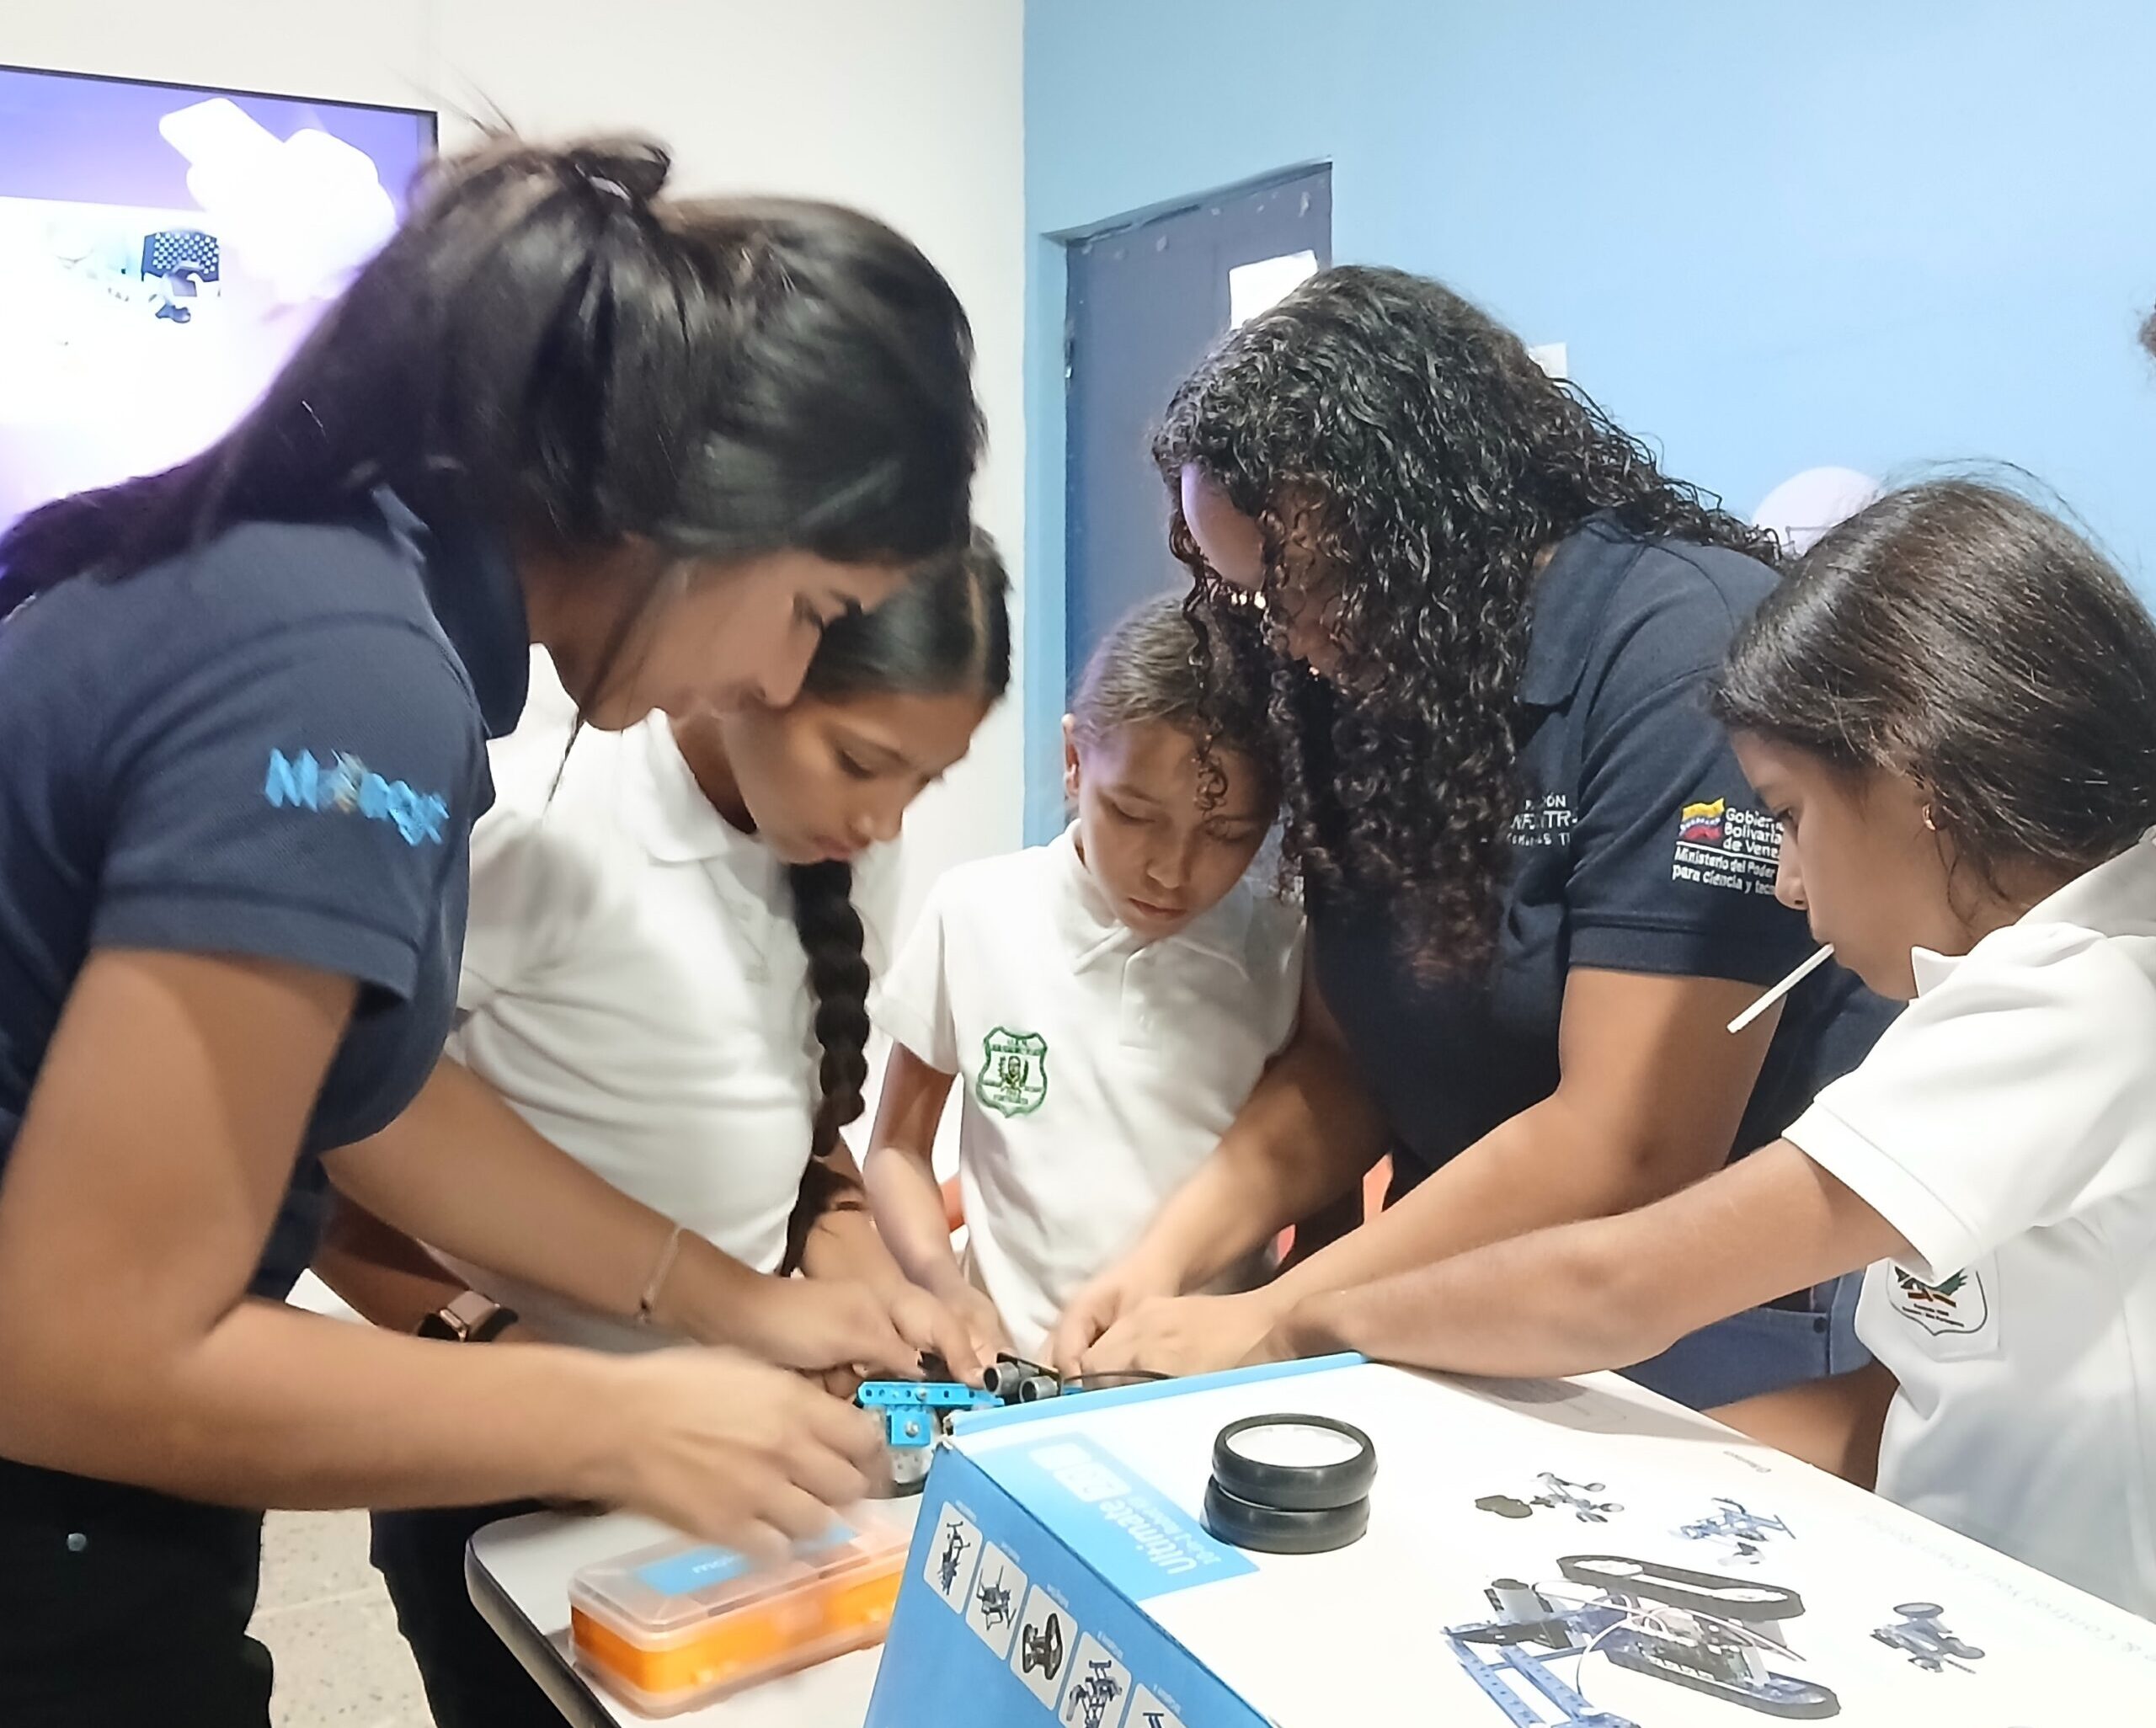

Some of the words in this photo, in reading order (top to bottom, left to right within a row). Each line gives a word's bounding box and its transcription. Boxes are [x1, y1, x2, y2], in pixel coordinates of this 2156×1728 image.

[1722, 837, 1742, 851] de
[1745, 840, 1780, 859] Vene
[1724, 822, 1783, 845] Bolivaria
[1674, 845, 1729, 870] Ministerio
[1730, 858, 1746, 873] del
[1748, 861, 1775, 878] Poder
[1672, 864, 1700, 881] para
[1702, 870, 1742, 890] ciencia
[1744, 881, 1752, 893] y
[1099, 1498, 1197, 1575] Ultimate
